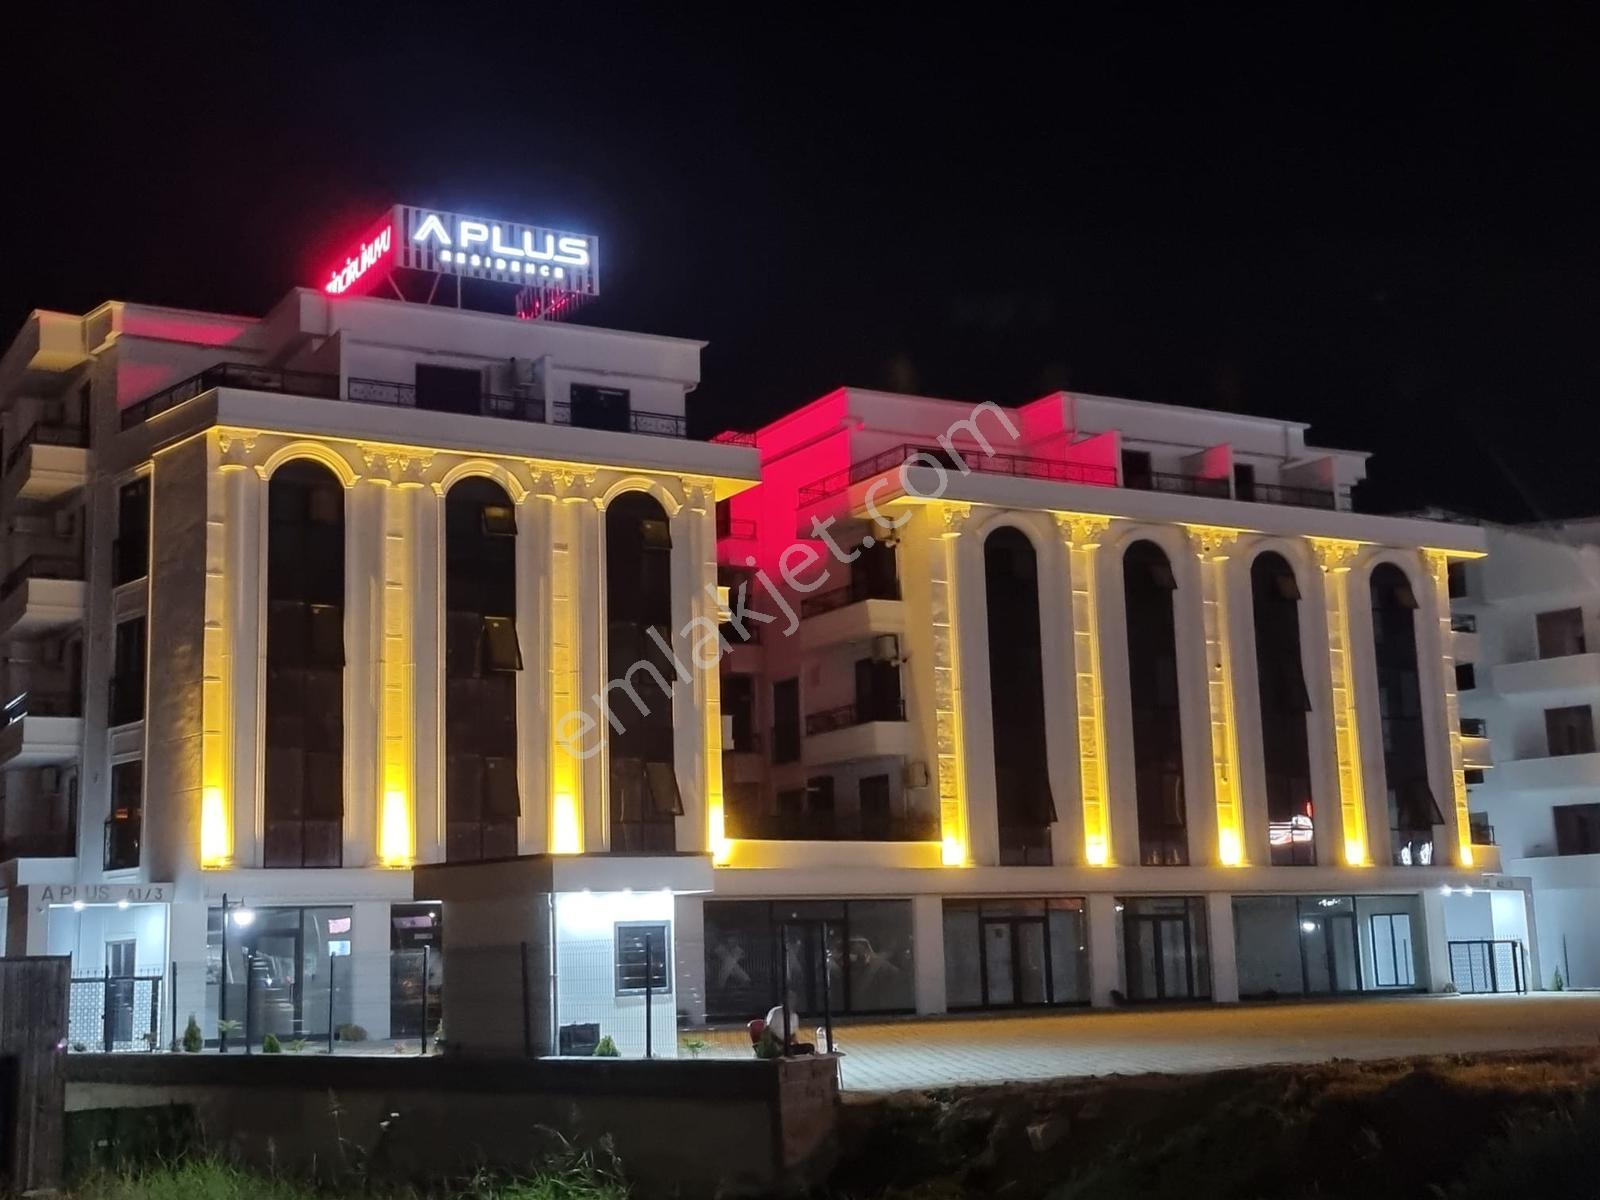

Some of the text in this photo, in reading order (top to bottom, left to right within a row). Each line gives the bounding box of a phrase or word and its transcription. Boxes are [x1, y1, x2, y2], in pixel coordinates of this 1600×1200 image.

[413, 214, 590, 266] A PLUS
[440, 249, 564, 279] RESIDENCE
[60, 884, 111, 900] PLUS
